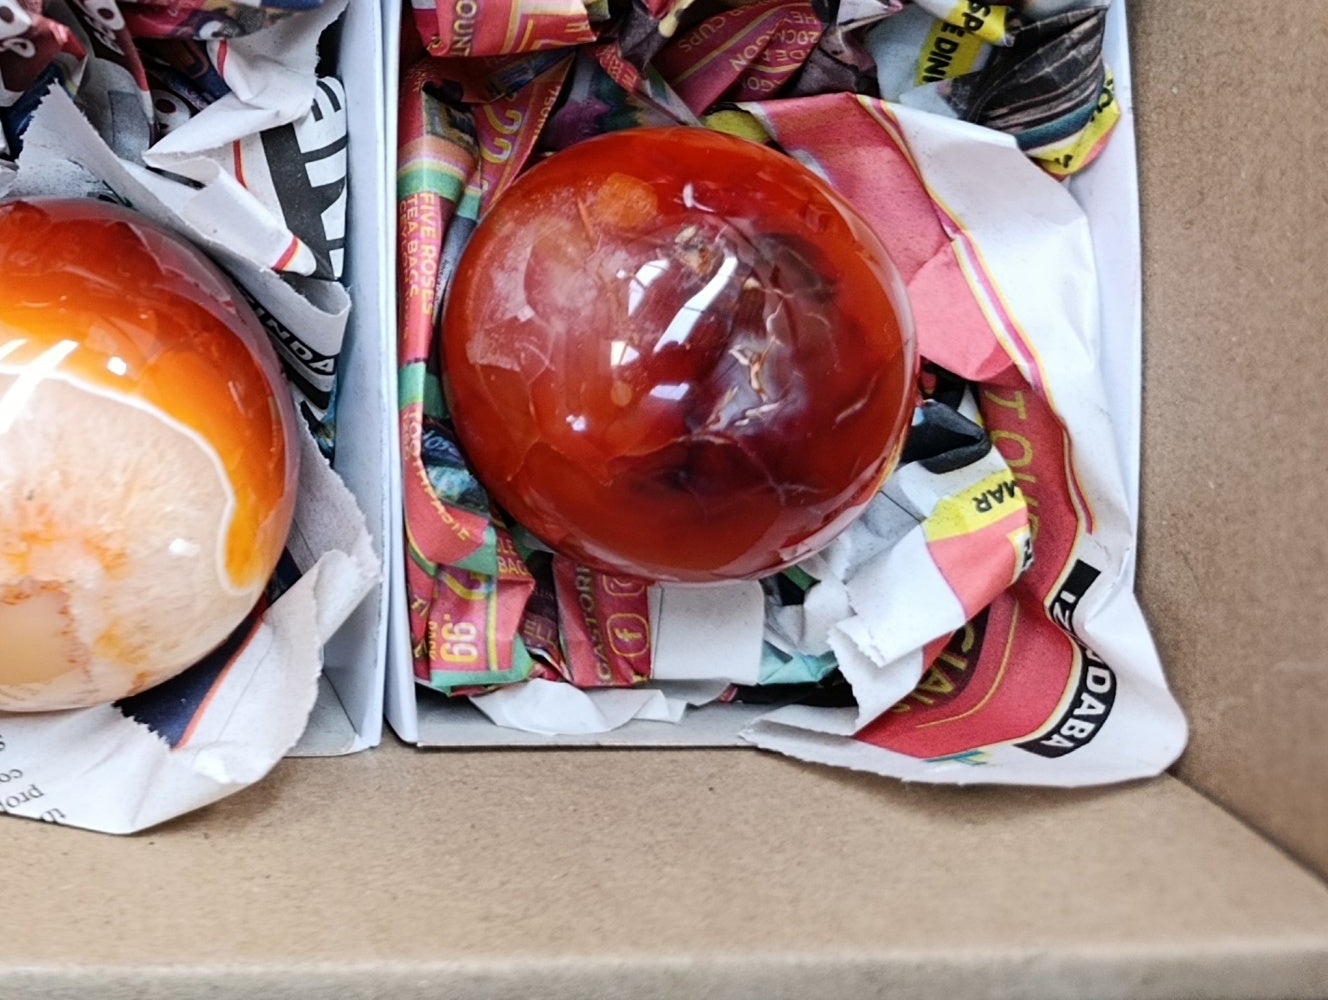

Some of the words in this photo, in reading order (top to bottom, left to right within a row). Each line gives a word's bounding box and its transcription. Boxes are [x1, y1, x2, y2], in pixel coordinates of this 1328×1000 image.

[676, 16, 728, 54] CUPS
[408, 195, 420, 234] TEA
[423, 191, 438, 239] FIVE
[420, 244, 438, 316] ROSES
